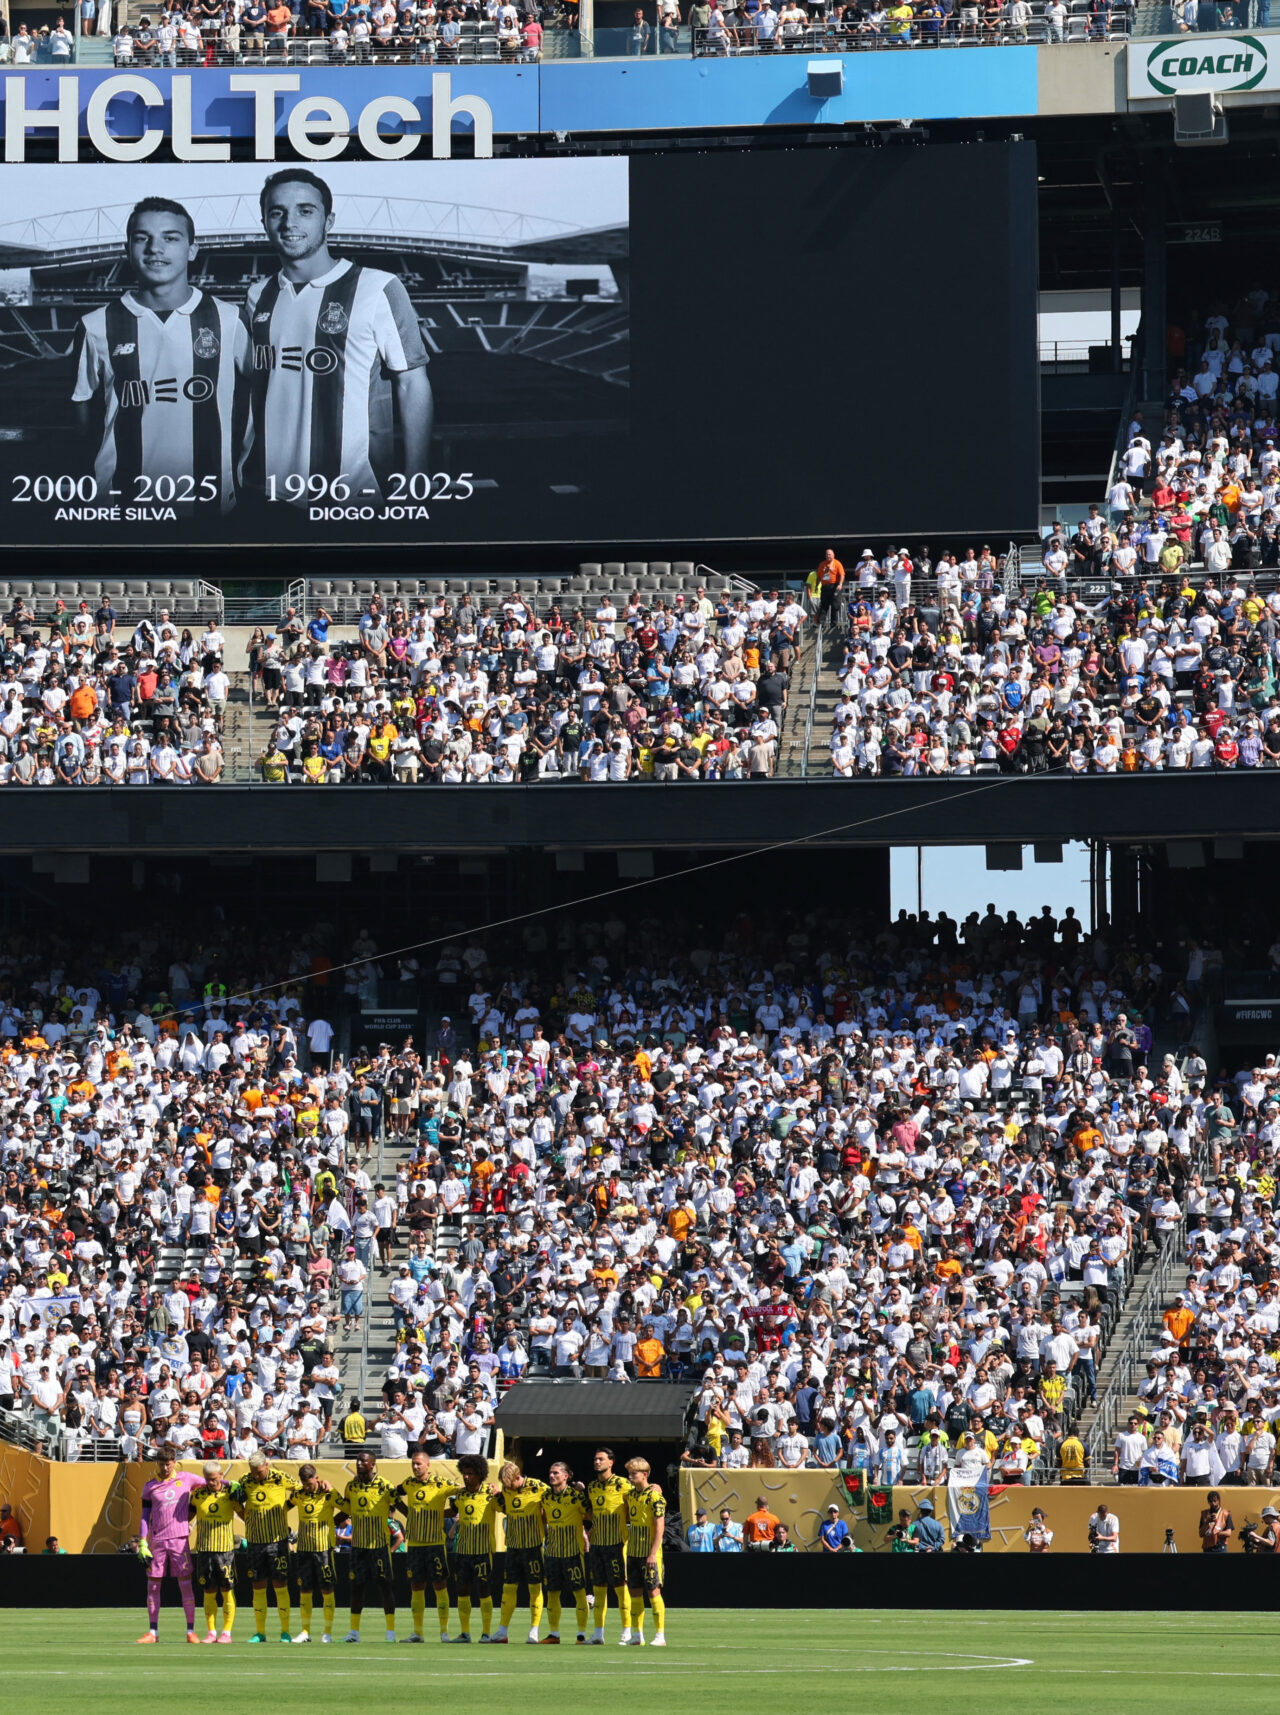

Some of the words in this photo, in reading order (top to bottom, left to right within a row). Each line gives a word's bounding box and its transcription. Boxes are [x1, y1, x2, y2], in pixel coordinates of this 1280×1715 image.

[1161, 53, 1254, 77] COACH
[5, 71, 494, 163] HCLTech
[11, 475, 98, 502] 2000
[133, 475, 218, 502] 2025
[266, 473, 350, 502] 1996
[387, 473, 475, 501] 2025
[54, 503, 121, 521] ANDRÉ
[125, 507, 177, 521] SILVA
[309, 506, 374, 521] DIOGO
[378, 506, 430, 520] JOTA
[1235, 1009, 1272, 1020] #FIFACWC
[274, 1556, 288, 1570] 25
[377, 1559, 384, 1572] 9
[433, 1557, 442, 1570] 3
[475, 1562, 487, 1577] 27
[529, 1560, 541, 1575] 10
[612, 1559, 620, 1573] 5
[321, 1565, 332, 1579] 13
[568, 1566, 582, 1581] 20
